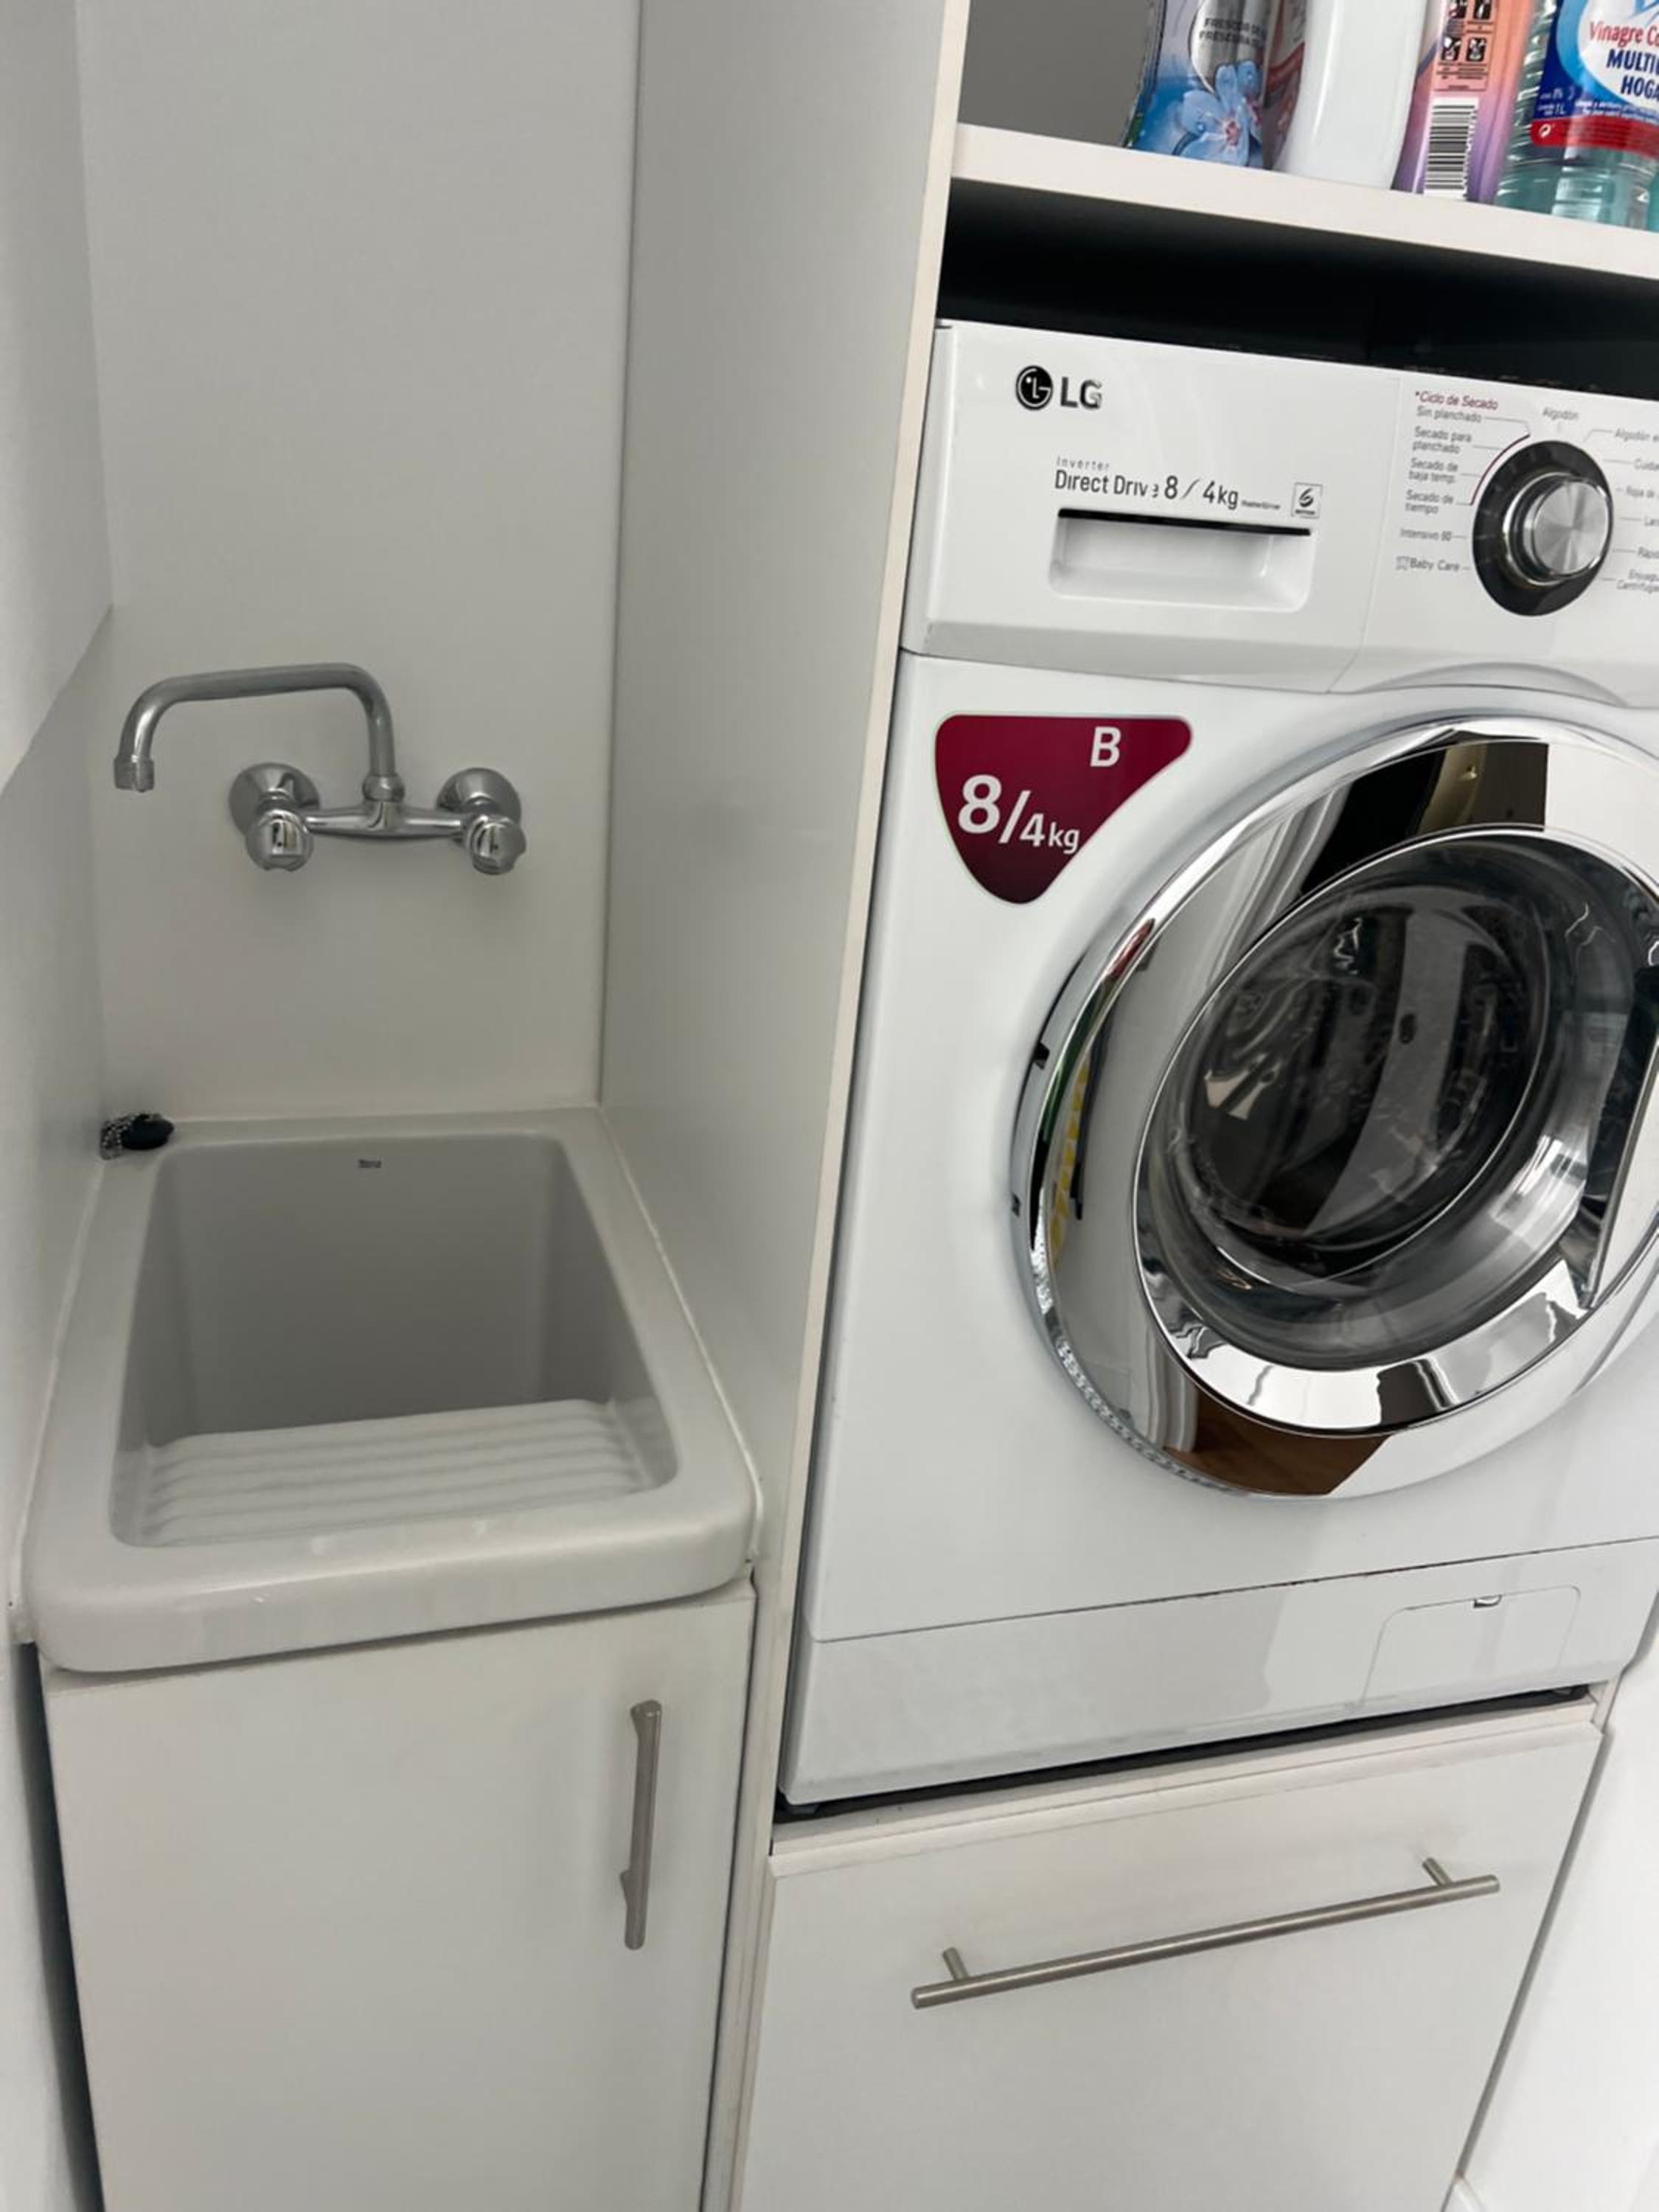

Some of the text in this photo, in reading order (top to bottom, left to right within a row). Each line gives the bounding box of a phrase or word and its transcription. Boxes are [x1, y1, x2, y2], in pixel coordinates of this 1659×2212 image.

[1589, 21, 1644, 47] Vinagre
[1060, 376, 1103, 409] LG
[1461, 394, 1499, 411] Secado
[1433, 409, 1482, 423] planchado
[1414, 425, 1472, 443] Secado para
[1412, 440, 1461, 455] planchado
[1057, 456, 1110, 471] Inverter
[1410, 458, 1444, 472] Secado
[1055, 469, 1110, 494] Direct
[1405, 489, 1440, 503] Secado
[1091, 726, 1121, 768] B
